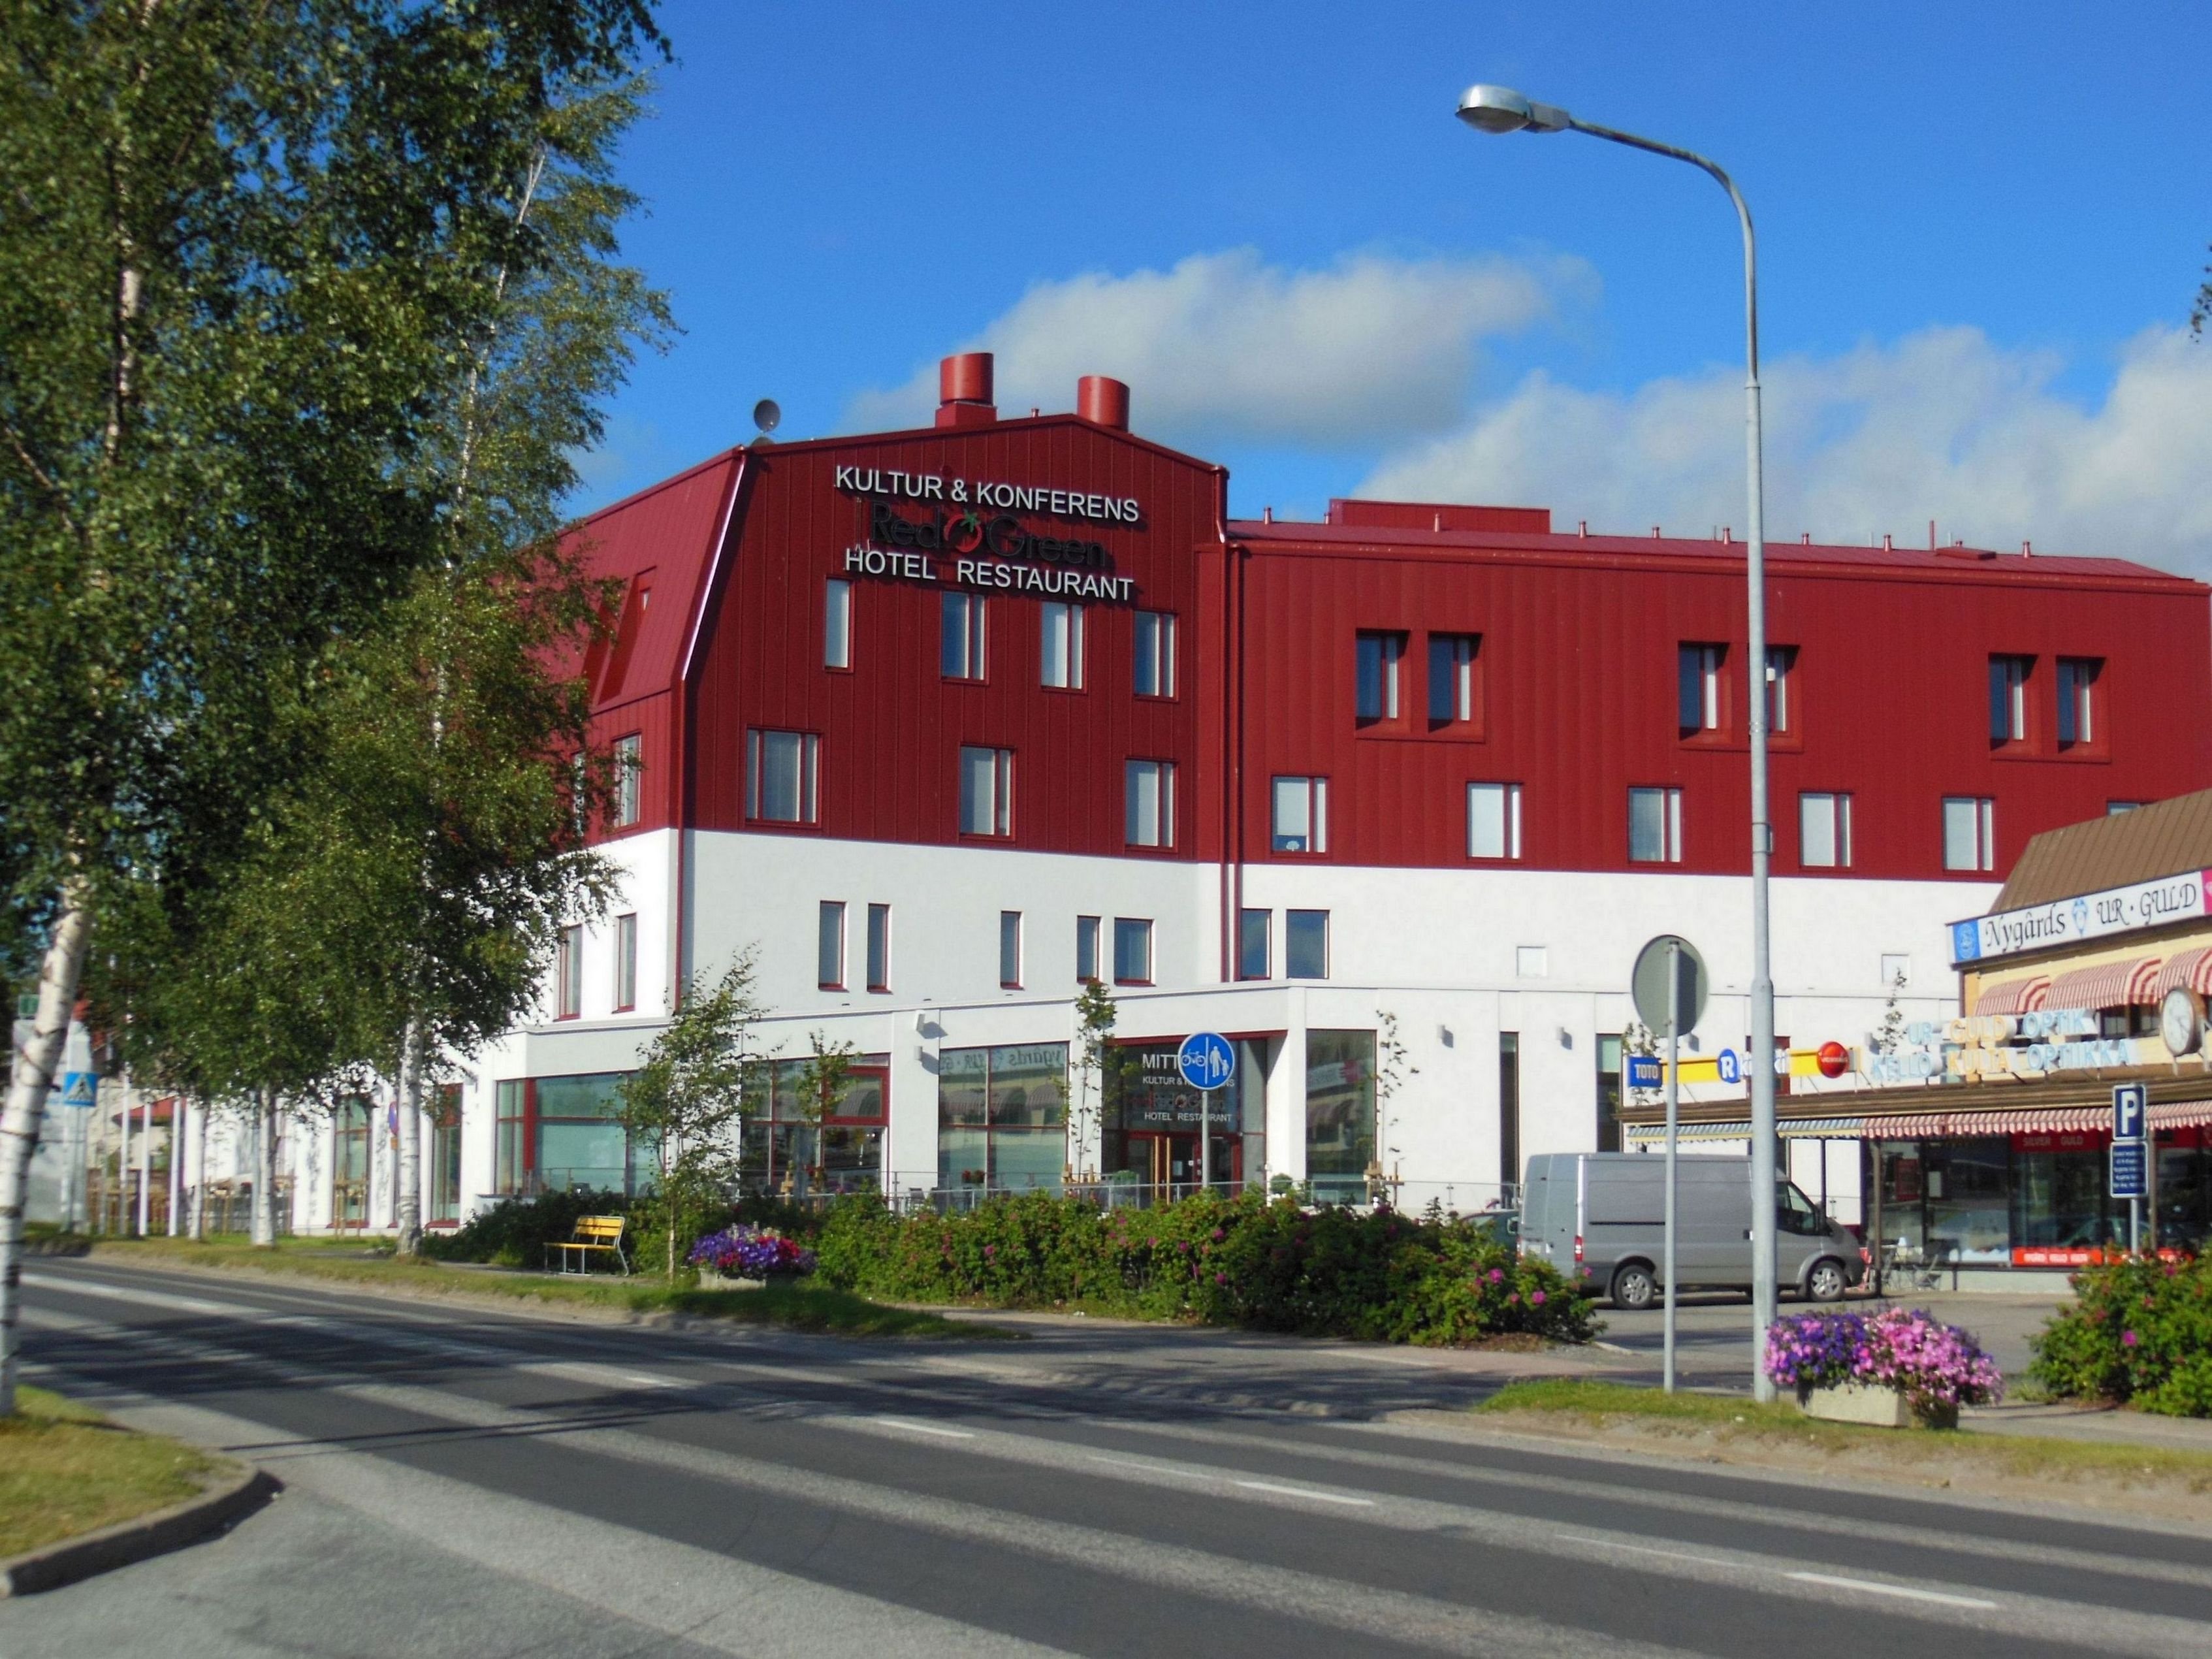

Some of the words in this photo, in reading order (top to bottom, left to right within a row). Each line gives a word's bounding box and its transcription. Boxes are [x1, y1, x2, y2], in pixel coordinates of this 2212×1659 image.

[835, 466, 943, 499] KULTUR
[951, 479, 968, 503] &
[976, 482, 1139, 521] KONFERENS
[871, 502, 941, 548] Red
[986, 515, 1106, 566] Green
[846, 548, 936, 579] HOTEL
[957, 560, 1134, 600] RESTAURANT
[2097, 898, 2130, 927] UR
[2140, 884, 2196, 926] GULD
[1907, 1022, 1933, 1044] UR
[1949, 1018, 2008, 1043] GULD
[2023, 1009, 2087, 1039] OPTIK
[1143, 1076, 1175, 1086] KULTUR
[1634, 1063, 1659, 1079] TOTO
[1720, 1056, 1735, 1078] R
[1872, 1052, 1933, 1079] KELLO
[1948, 1048, 2010, 1075] KULTA
[1145, 1112, 1173, 1121] HOTEL
[1178, 1112, 1232, 1122] RESTARANT
[2121, 1091, 2138, 1135] P
